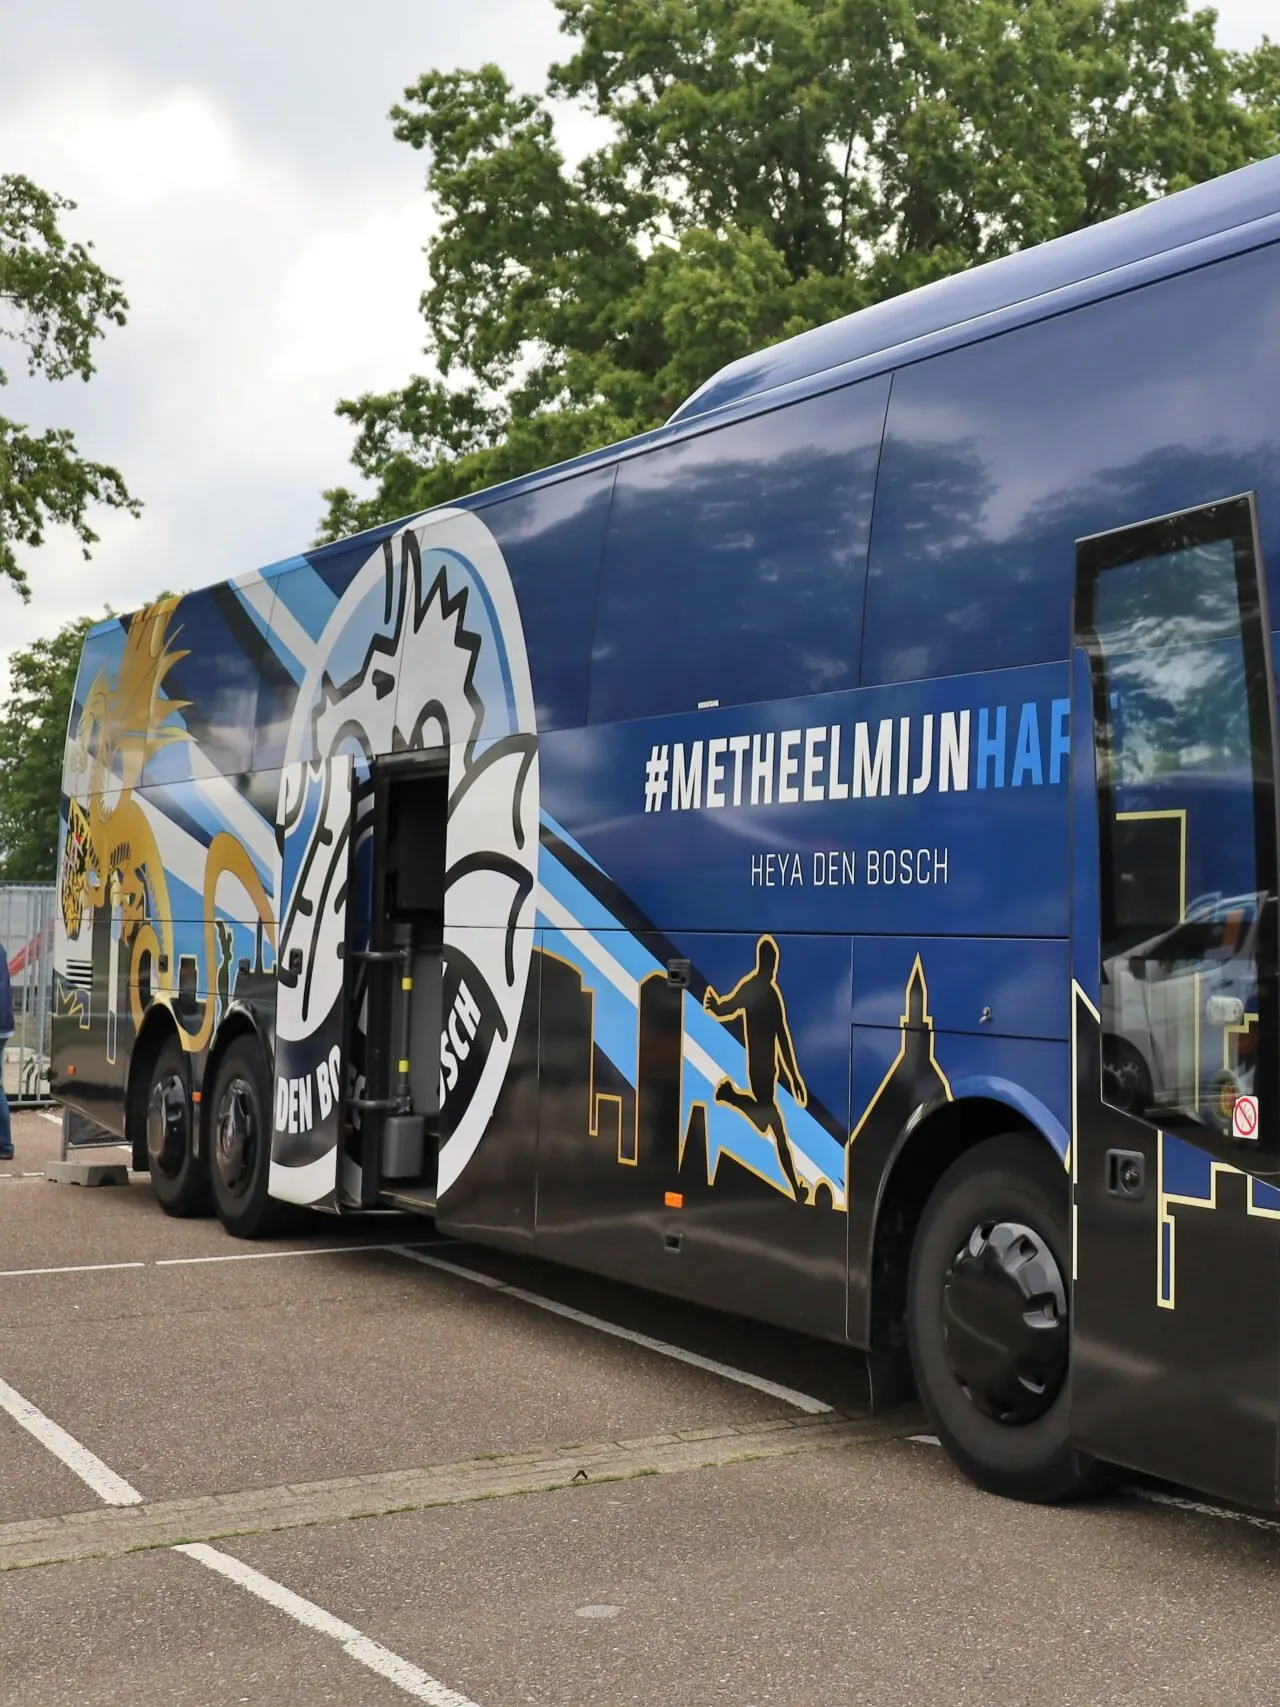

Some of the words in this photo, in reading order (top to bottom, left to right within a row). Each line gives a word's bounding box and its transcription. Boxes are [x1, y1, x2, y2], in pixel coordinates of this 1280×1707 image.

[751, 853, 803, 887] HEYA
[813, 850, 856, 886] DEN
[867, 847, 949, 885] BOSCH
[440, 979, 482, 1110] SCH
[275, 1074, 313, 1134] DEN
